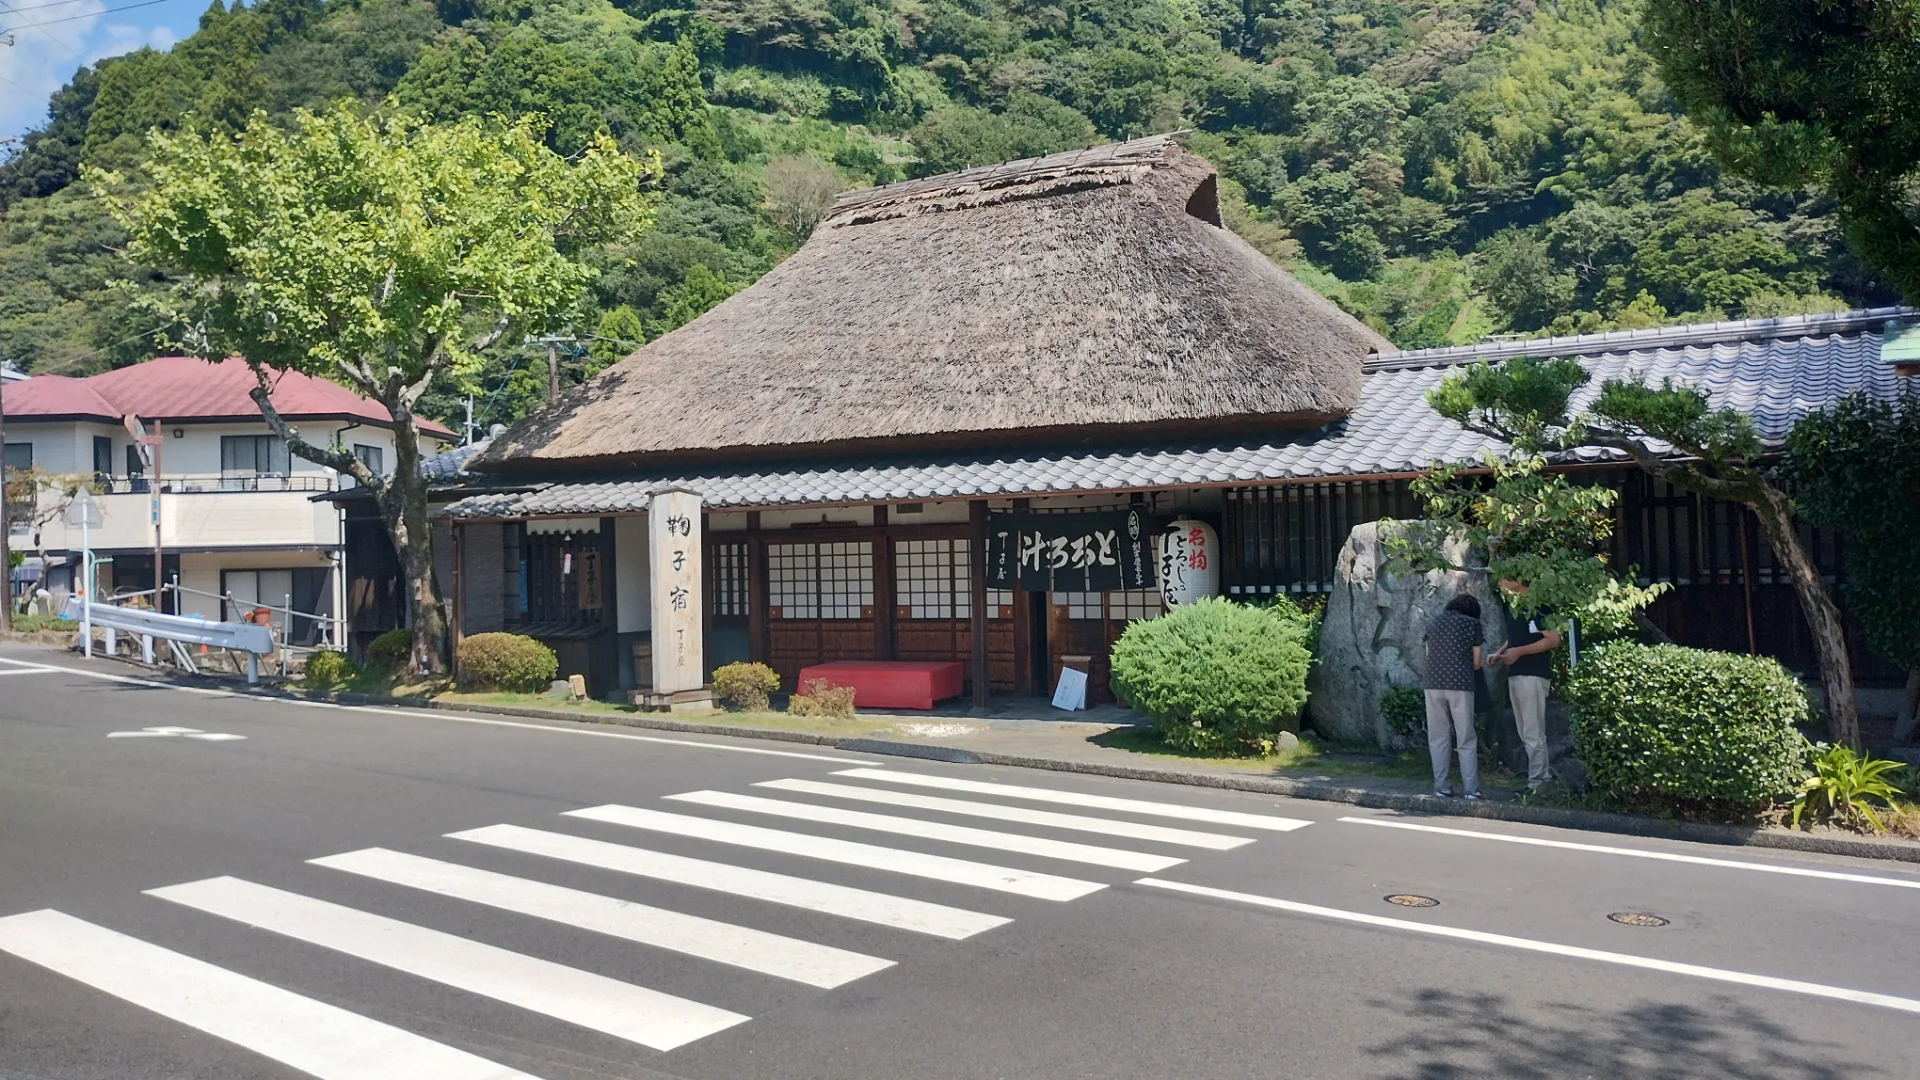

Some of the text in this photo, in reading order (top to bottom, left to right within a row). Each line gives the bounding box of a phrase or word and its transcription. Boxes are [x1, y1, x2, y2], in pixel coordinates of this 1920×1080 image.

[666, 513, 691, 612] 鞠子宿
[997, 531, 1008, 580] 丁子屋
[1161, 526, 1181, 605] 丁子屋
[1188, 527, 1208, 571] 名物
